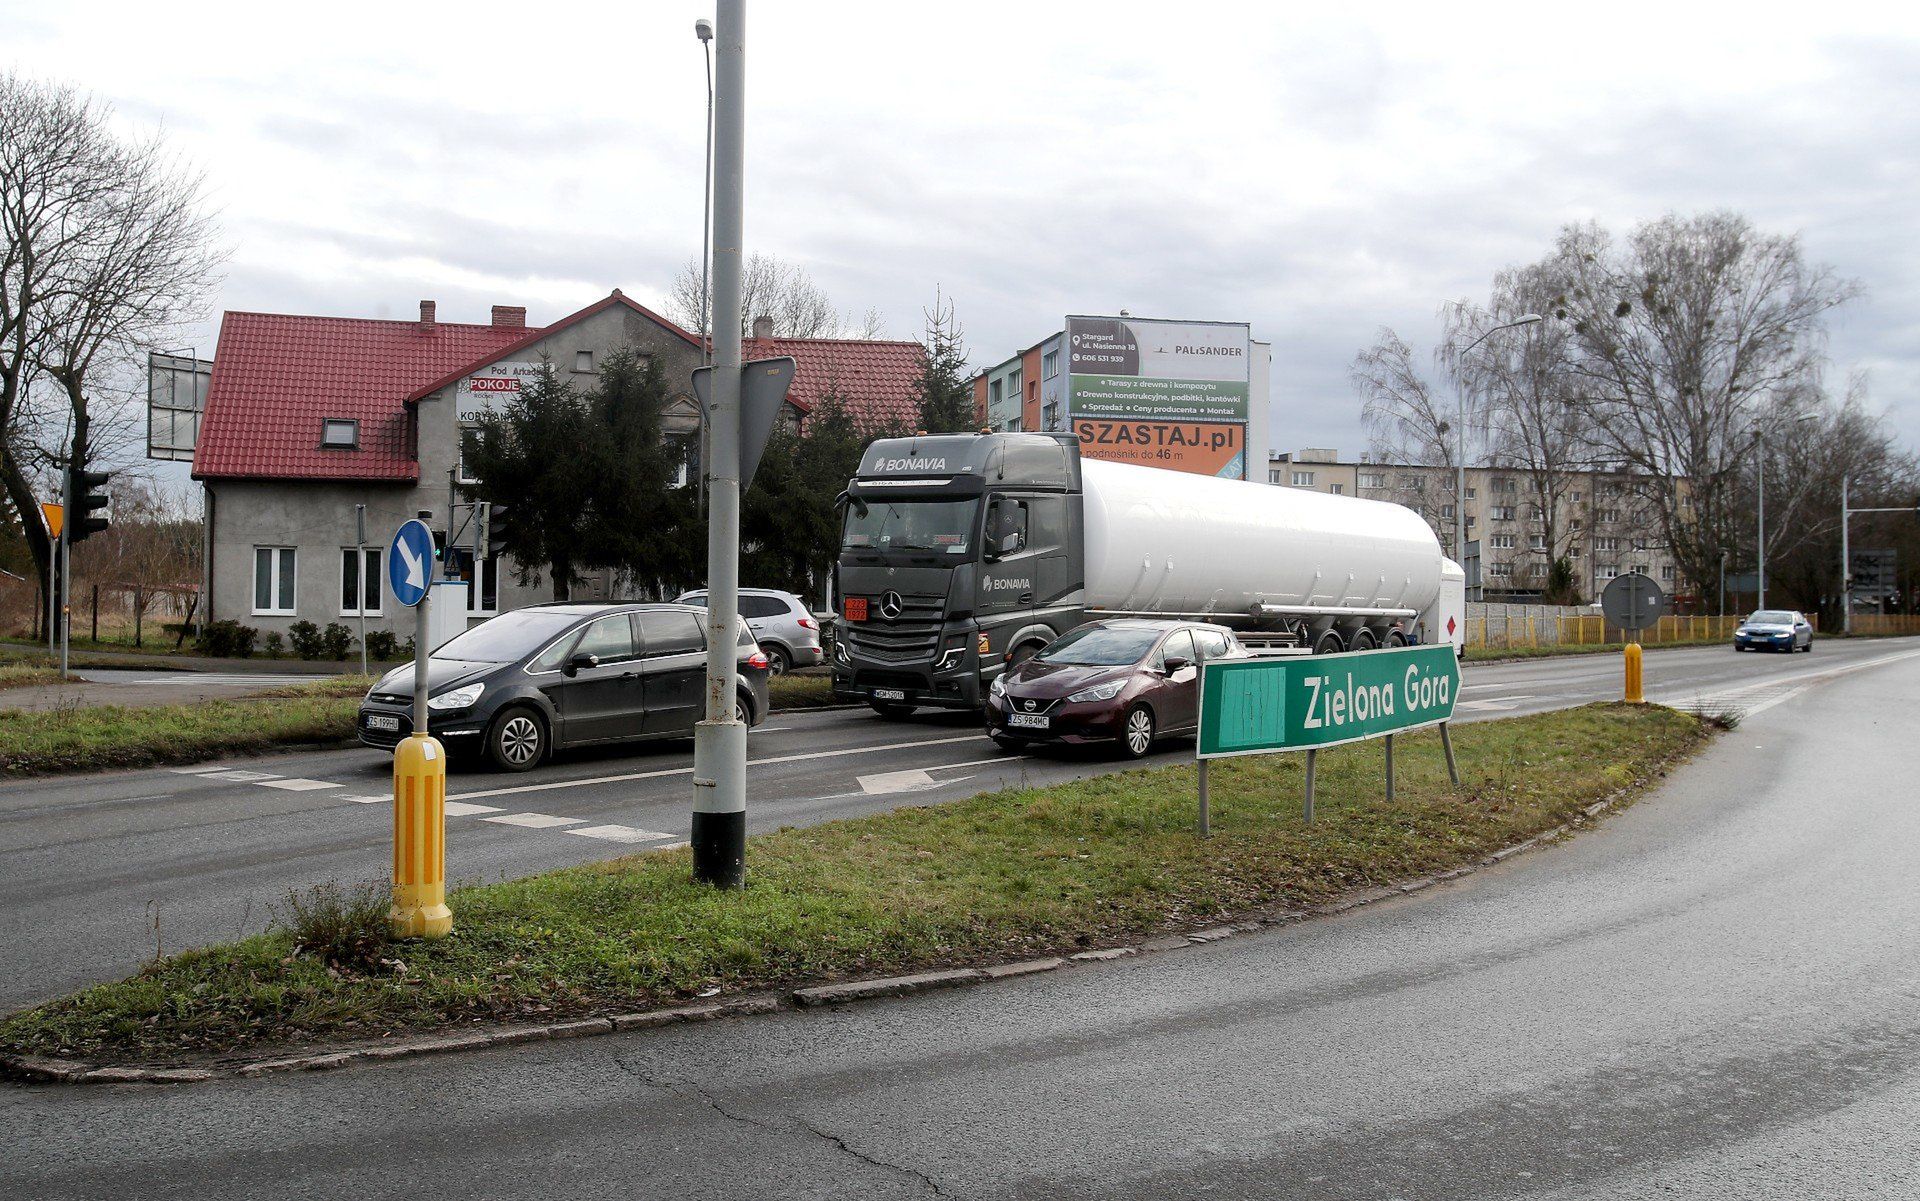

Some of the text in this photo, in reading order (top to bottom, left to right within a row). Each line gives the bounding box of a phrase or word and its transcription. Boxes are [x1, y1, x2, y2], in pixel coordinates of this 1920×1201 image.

[1082, 333, 1114, 342] Stargard
[1127, 343, 1136, 351] 18
[1082, 354, 1096, 362] 606
[1110, 355, 1124, 363] 939
[491, 366, 507, 375] Pod
[470, 380, 519, 390] POKOJE
[1107, 379, 1132, 389] Tarasy
[1139, 381, 1168, 389] drewna
[1173, 382, 1217, 391] kompozytu
[1083, 391, 1241, 403] Drewno konstrukcyjne, podbitki, kantówki
[1088, 403, 1235, 415] Sprzedaż Ceny producenta Montaż
[1079, 423, 1233, 452] SZASTAJ.pl
[1086, 448, 1184, 460] podnośniki do 46 m
[886, 458, 946, 471] BONAVIA
[994, 578, 1031, 590] BONAVIA
[1303, 663, 1449, 729] Zielona Góra
[370, 716, 378, 726] ZS
[1012, 715, 1048, 726] ZS 984MC
